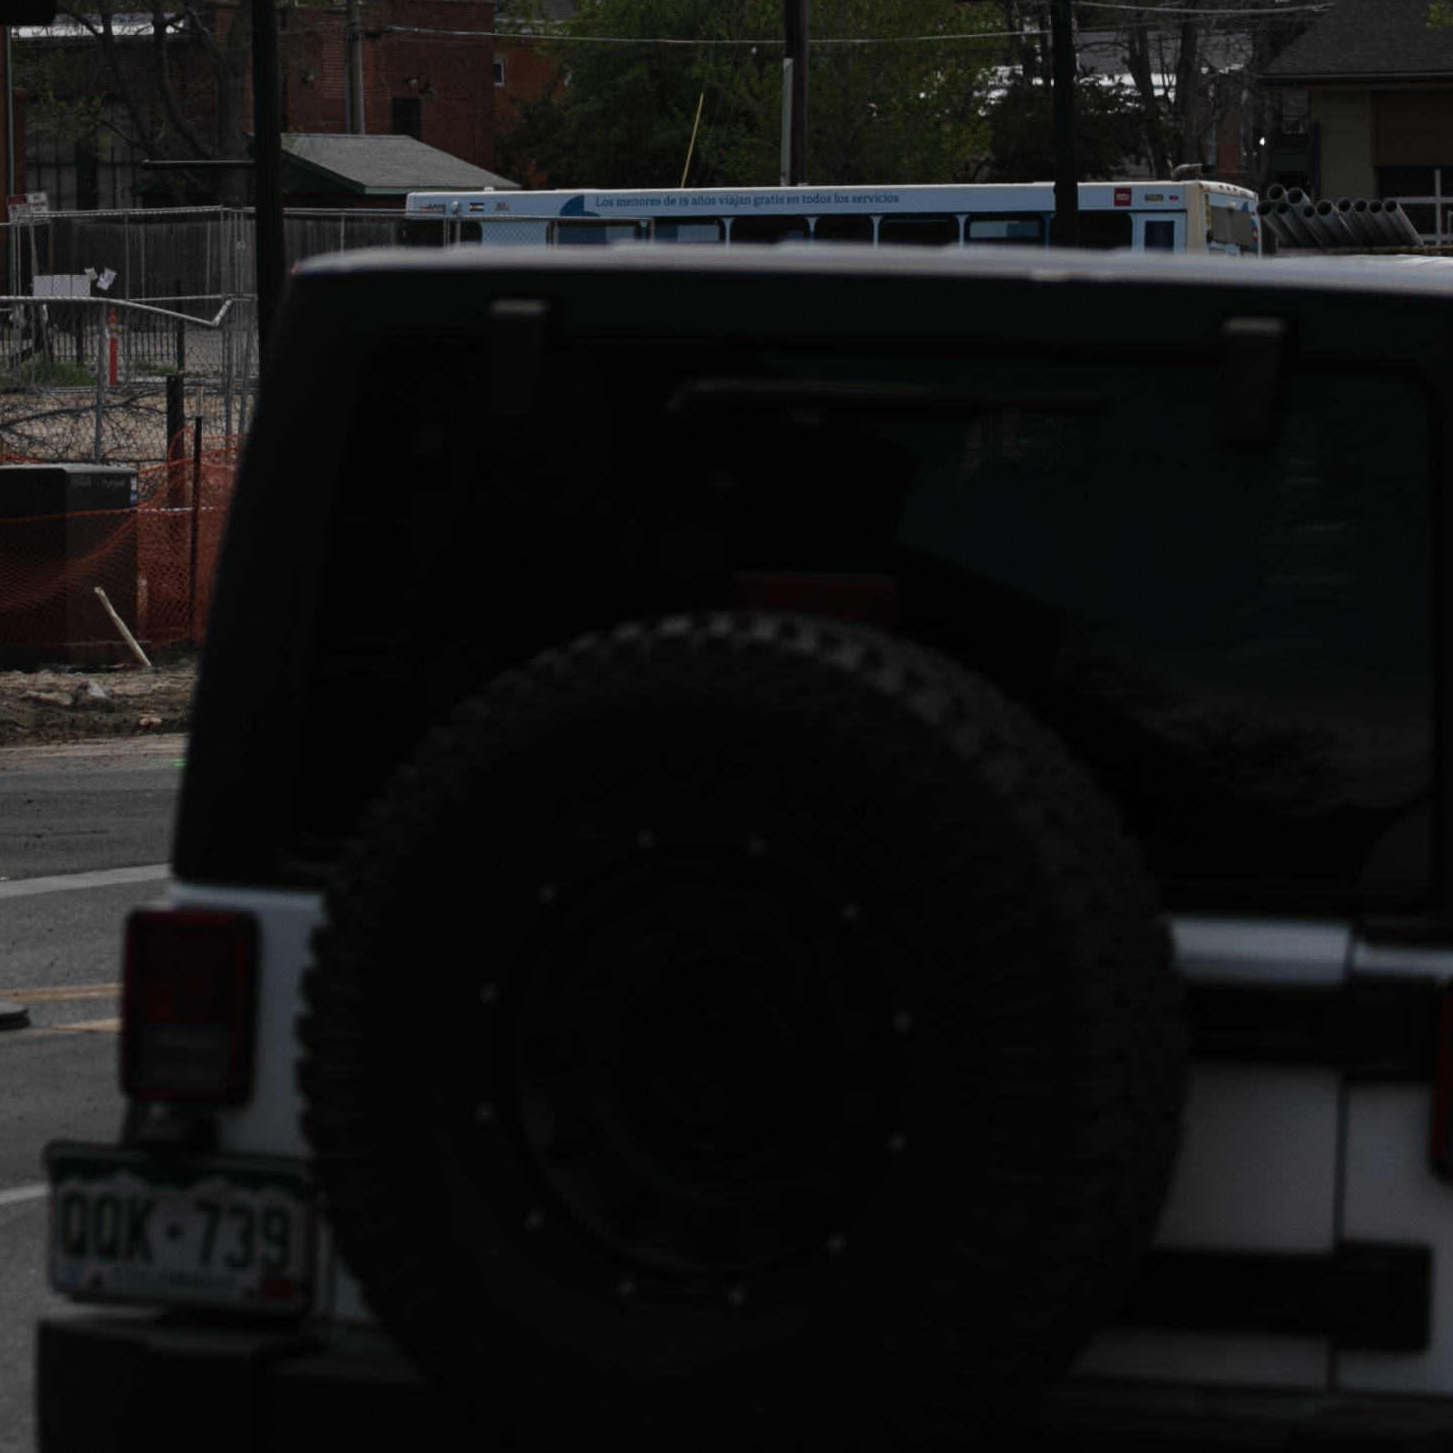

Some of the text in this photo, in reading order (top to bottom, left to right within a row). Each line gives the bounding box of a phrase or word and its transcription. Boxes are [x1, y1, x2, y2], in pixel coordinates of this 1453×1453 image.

[595, 192, 900, 208] Los menores de 19 años viajan gratis en todos los servicios
[1144, 193, 1164, 203] 6029
